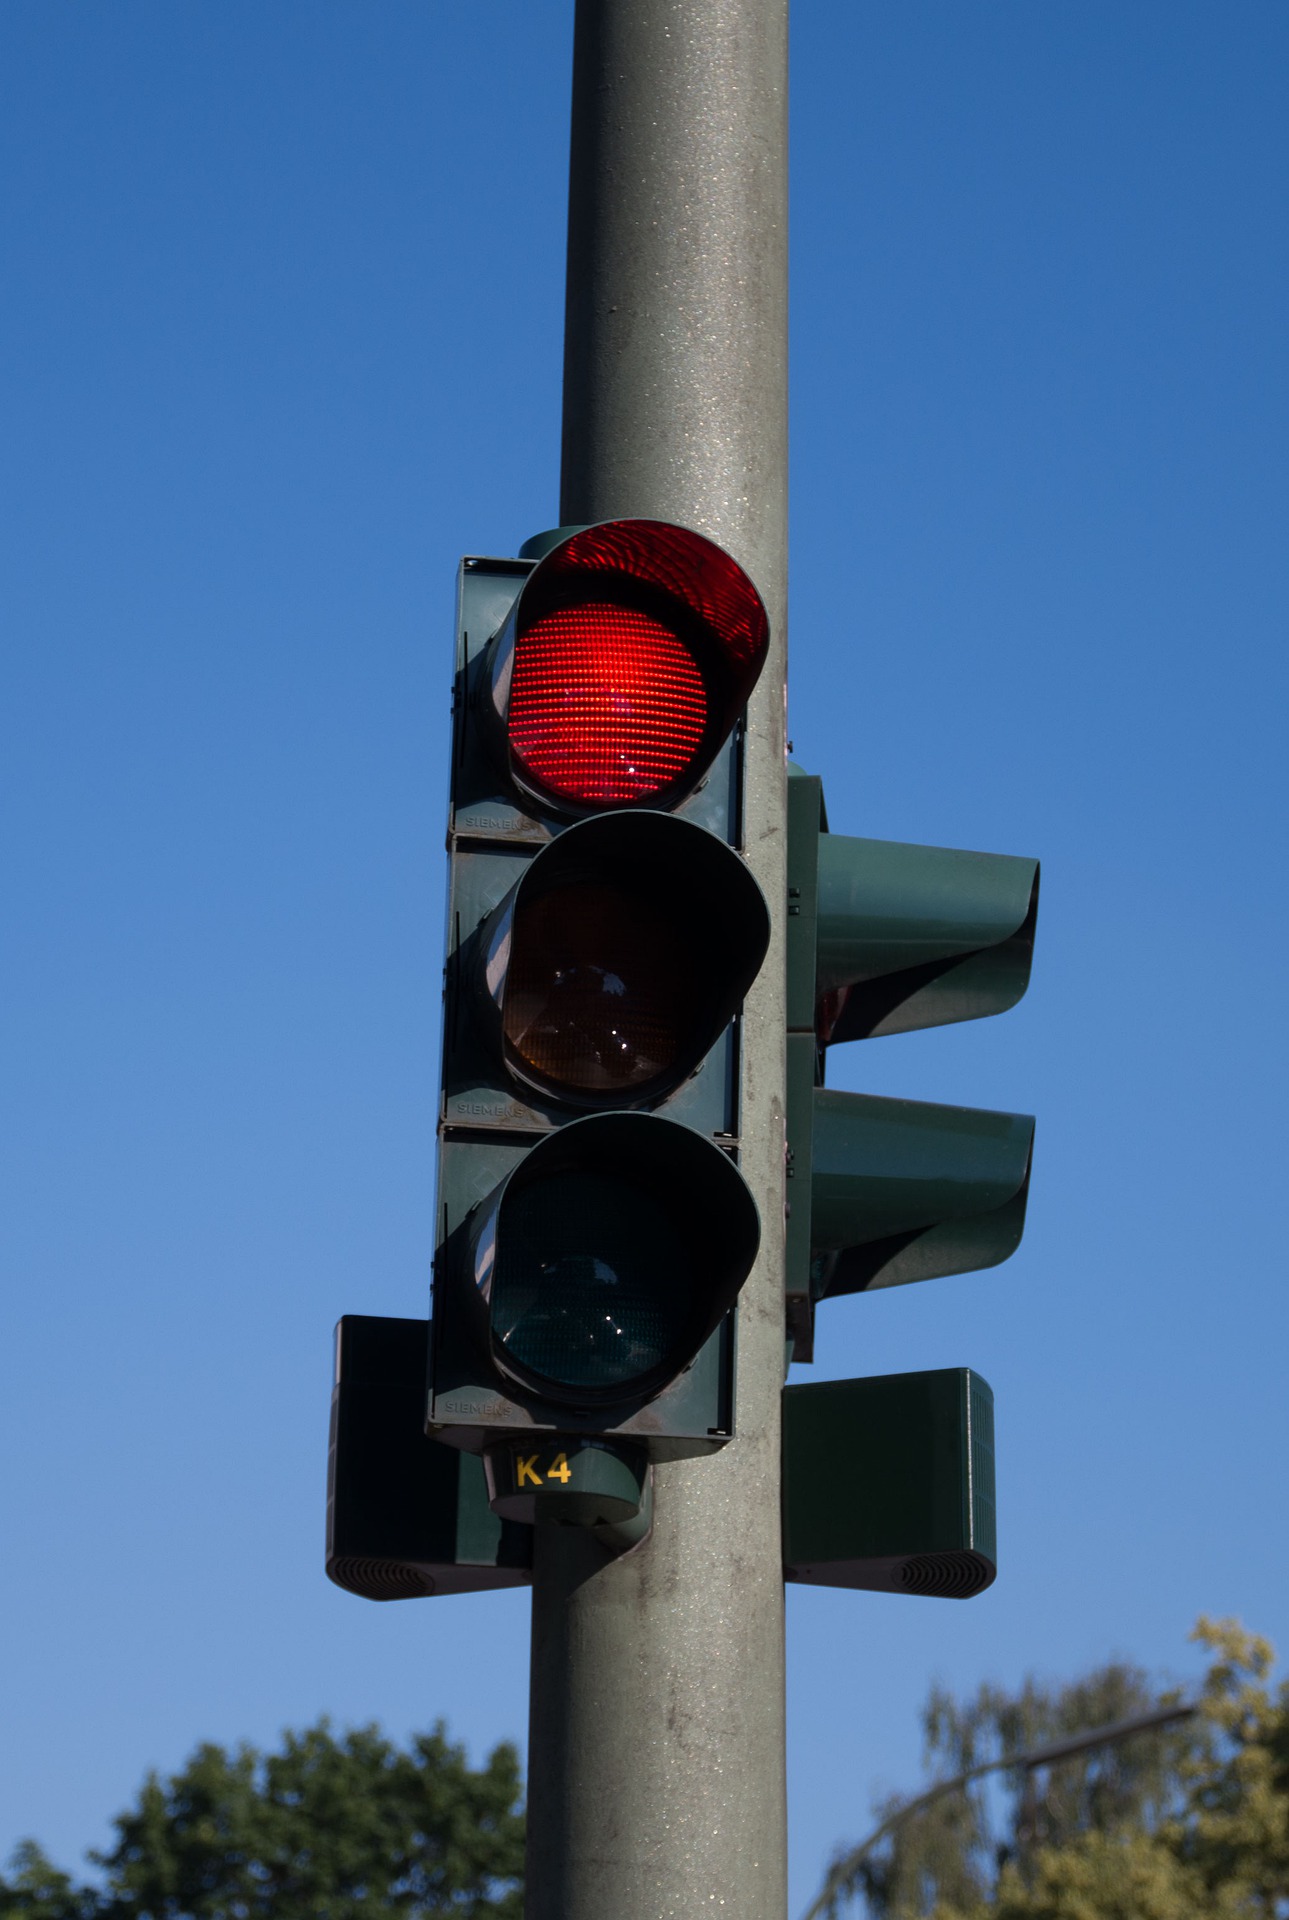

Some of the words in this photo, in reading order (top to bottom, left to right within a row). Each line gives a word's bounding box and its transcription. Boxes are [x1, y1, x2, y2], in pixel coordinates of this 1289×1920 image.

[465, 816, 531, 831] SIEMENS
[458, 1103, 523, 1118] SIEMENS
[446, 1401, 513, 1416] SIEMENS
[516, 1452, 572, 1487] K4
